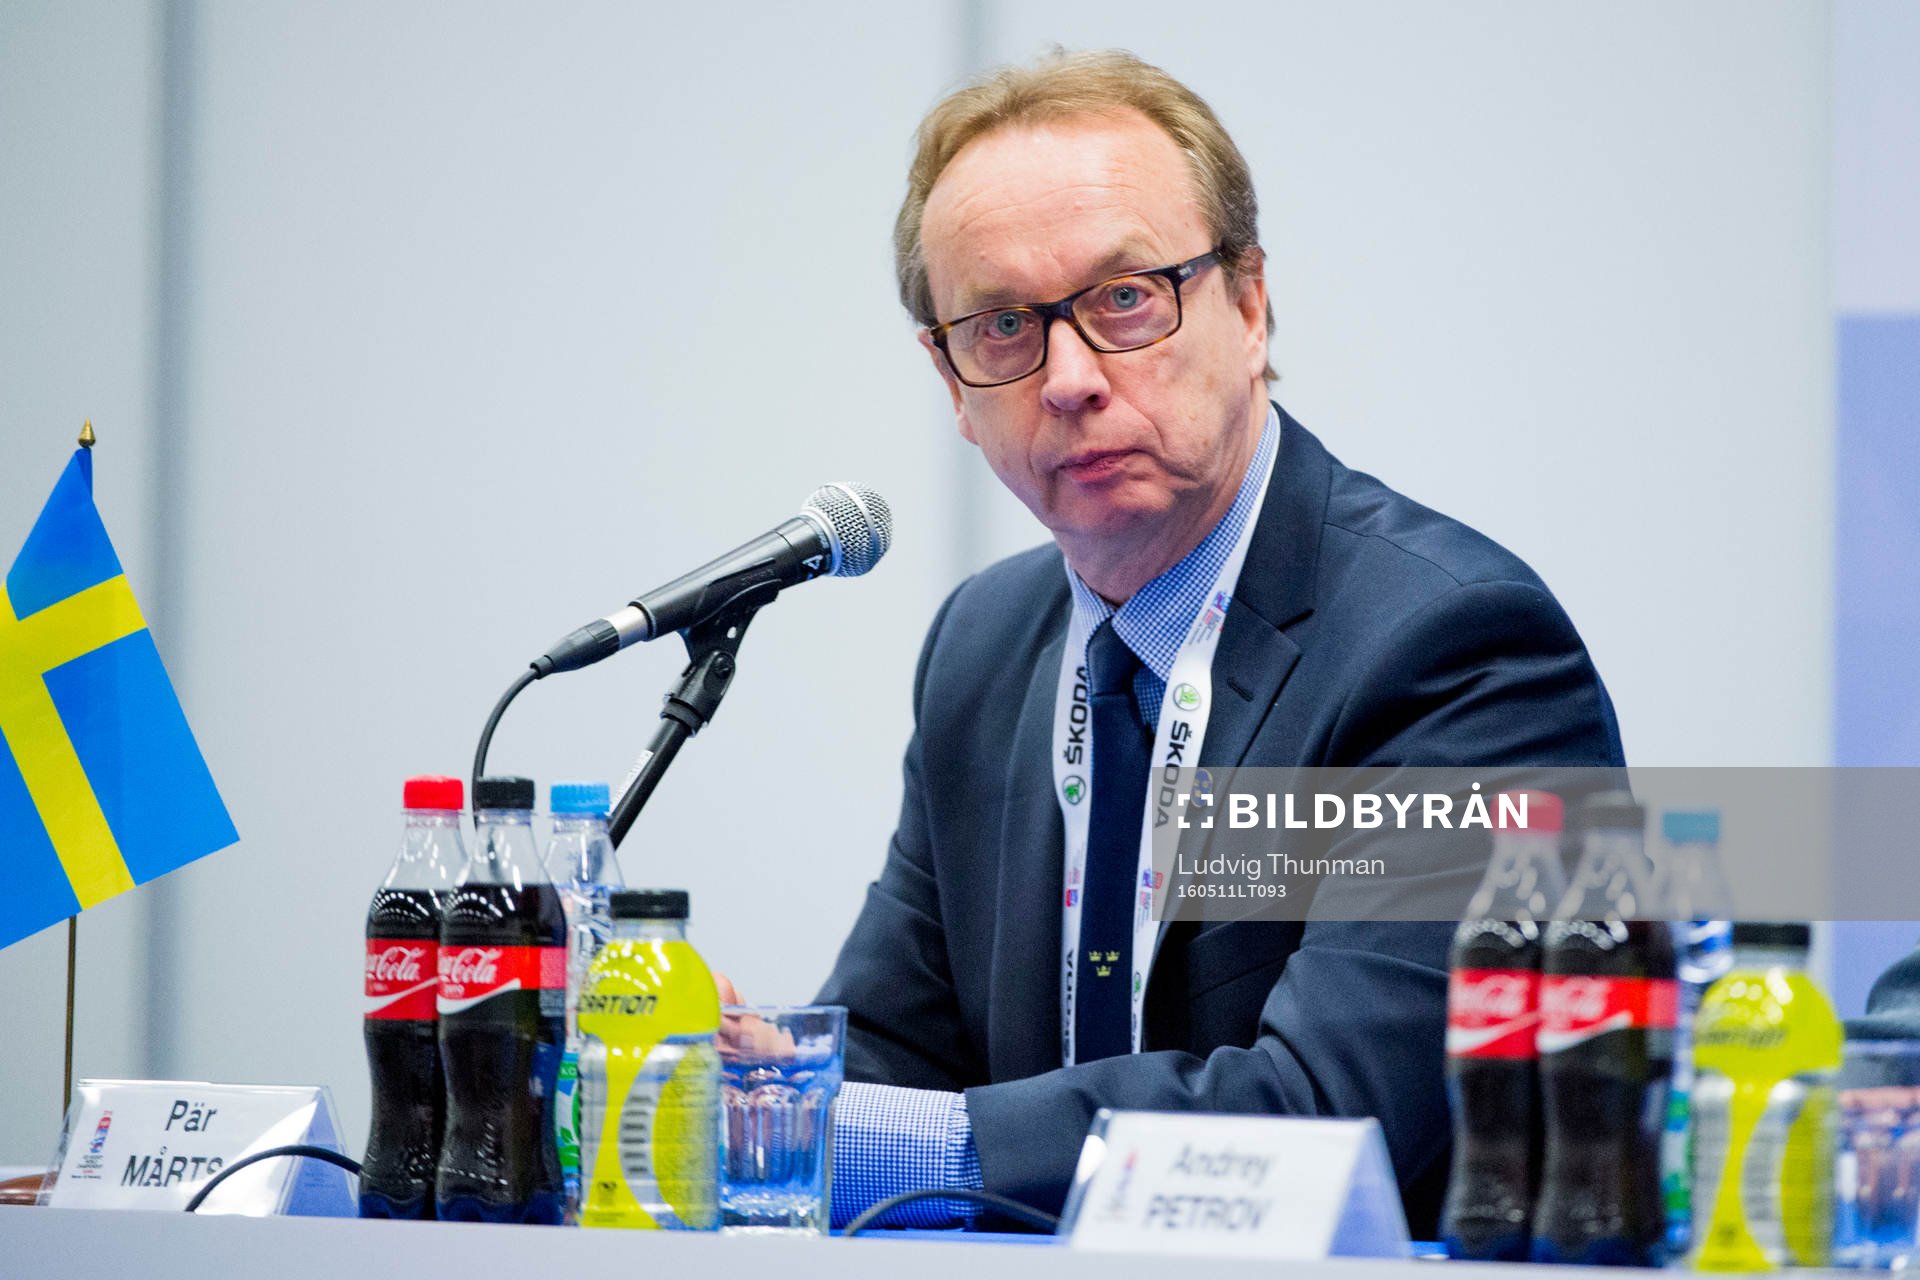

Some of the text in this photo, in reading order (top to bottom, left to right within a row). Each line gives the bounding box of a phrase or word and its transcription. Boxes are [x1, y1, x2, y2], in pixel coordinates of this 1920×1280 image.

[1154, 720, 1193, 828] ŠKODA
[165, 1100, 218, 1132] Pär
[120, 1146, 224, 1187] MÅRTS
[1169, 1143, 1275, 1184] Andrey
[1144, 1195, 1272, 1230] PETROV
